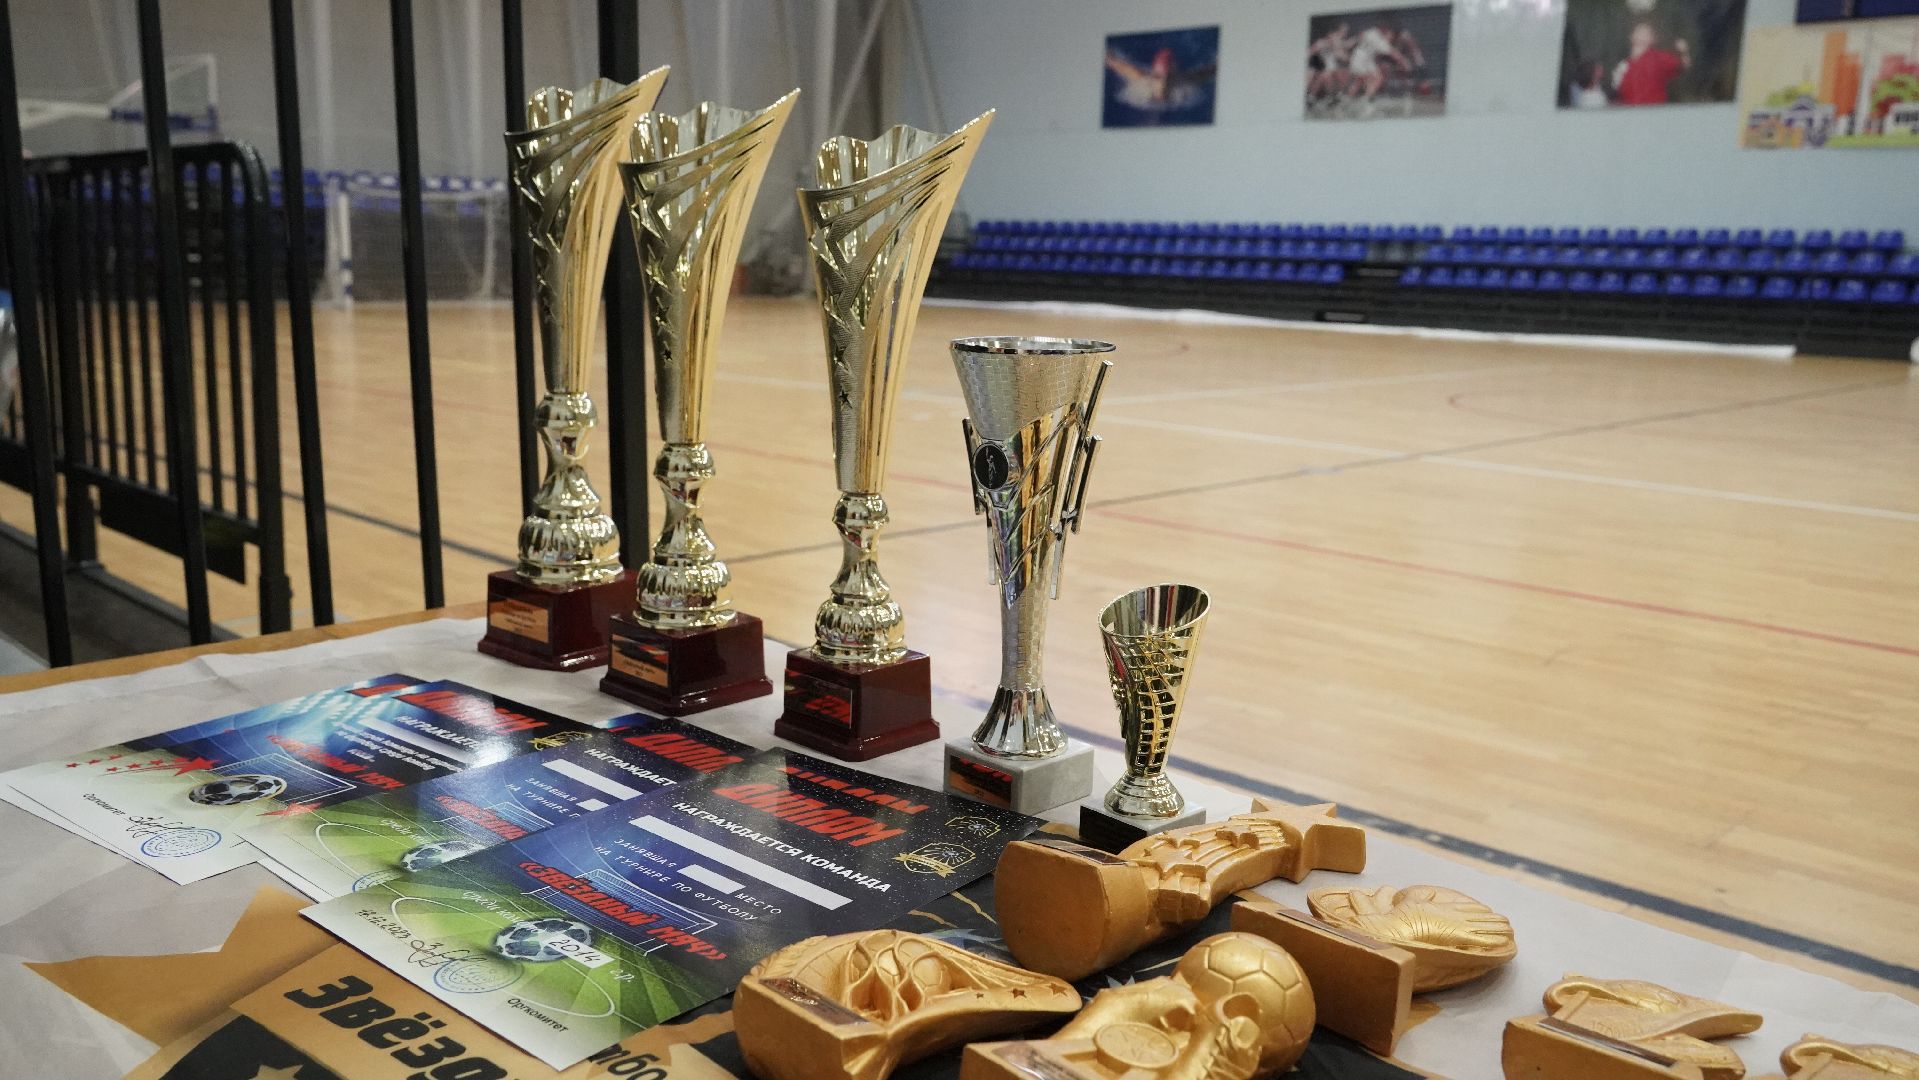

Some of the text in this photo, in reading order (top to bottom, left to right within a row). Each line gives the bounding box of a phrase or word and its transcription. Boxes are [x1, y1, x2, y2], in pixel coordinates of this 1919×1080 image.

[584, 748, 677, 787] НАГРАЖДАЕТ
[623, 732, 745, 775] ДИПЛ
[505, 783, 581, 819] НА ТУРНИРЕ П
[525, 777, 577, 802] ЗАНЯВШАЯ
[711, 783, 907, 848] ДИПЛОМ
[672, 802, 893, 893] НАГРАЖДАЕТСЯ КОМАНДА
[593, 846, 758, 921] НА ТУРНИРЕ ПО ФУТБОЛУ
[614, 838, 782, 915] ЗАНЯВШАЯ МЕСТО
[548, 939, 601, 962] 2014
[507, 998, 569, 1033] Оргкомитет
